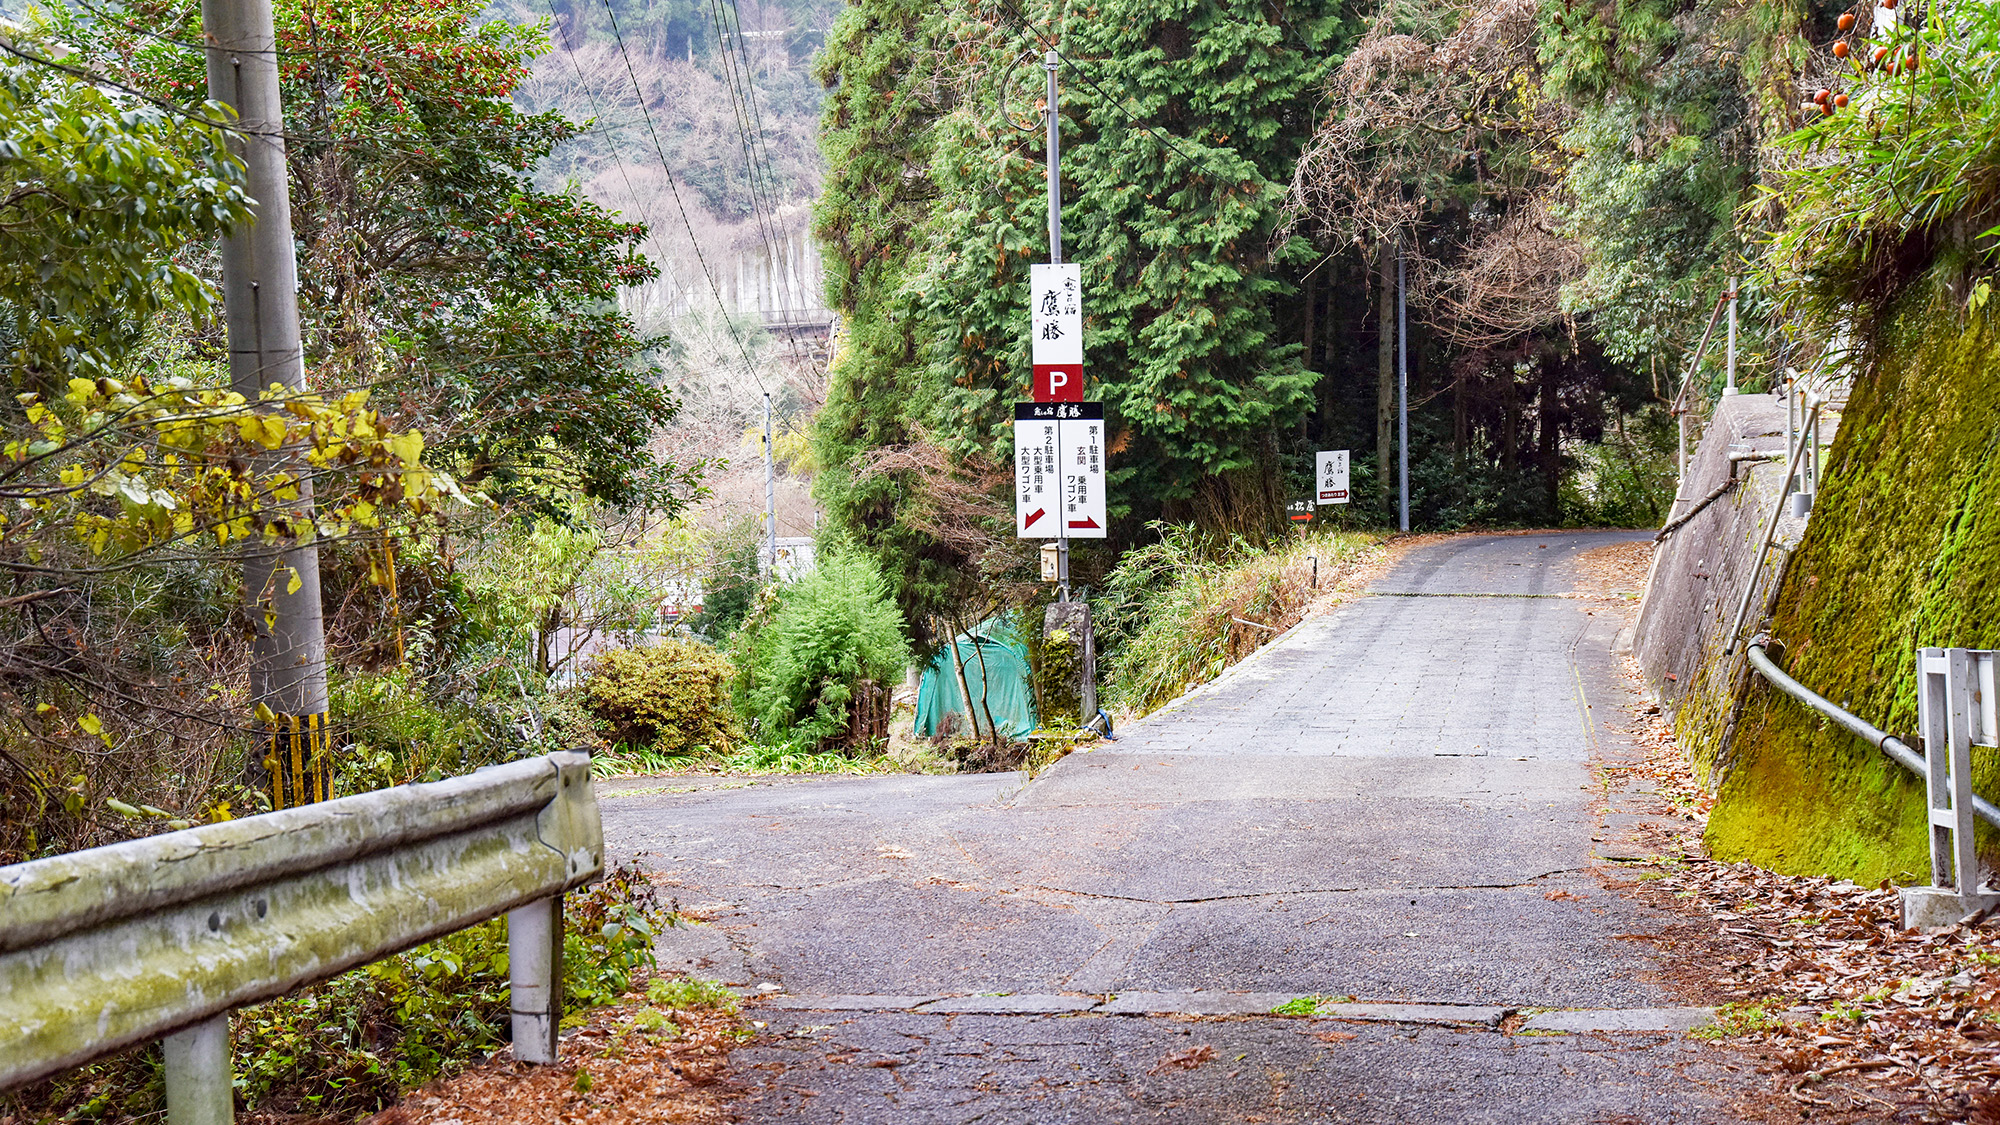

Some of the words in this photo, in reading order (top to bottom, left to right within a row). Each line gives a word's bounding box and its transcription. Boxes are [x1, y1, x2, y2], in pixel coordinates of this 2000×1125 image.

[1040, 289, 1065, 340] 鷹勝
[1049, 371, 1068, 396] P
[1020, 446, 1031, 504] 大型ワゴン車
[1033, 446, 1044, 494] 大型乗用車
[1043, 425, 1054, 475] 第2駐車場
[1088, 425, 1099, 475] 第1駐車場
[1067, 475, 1077, 513] ワゴン車
